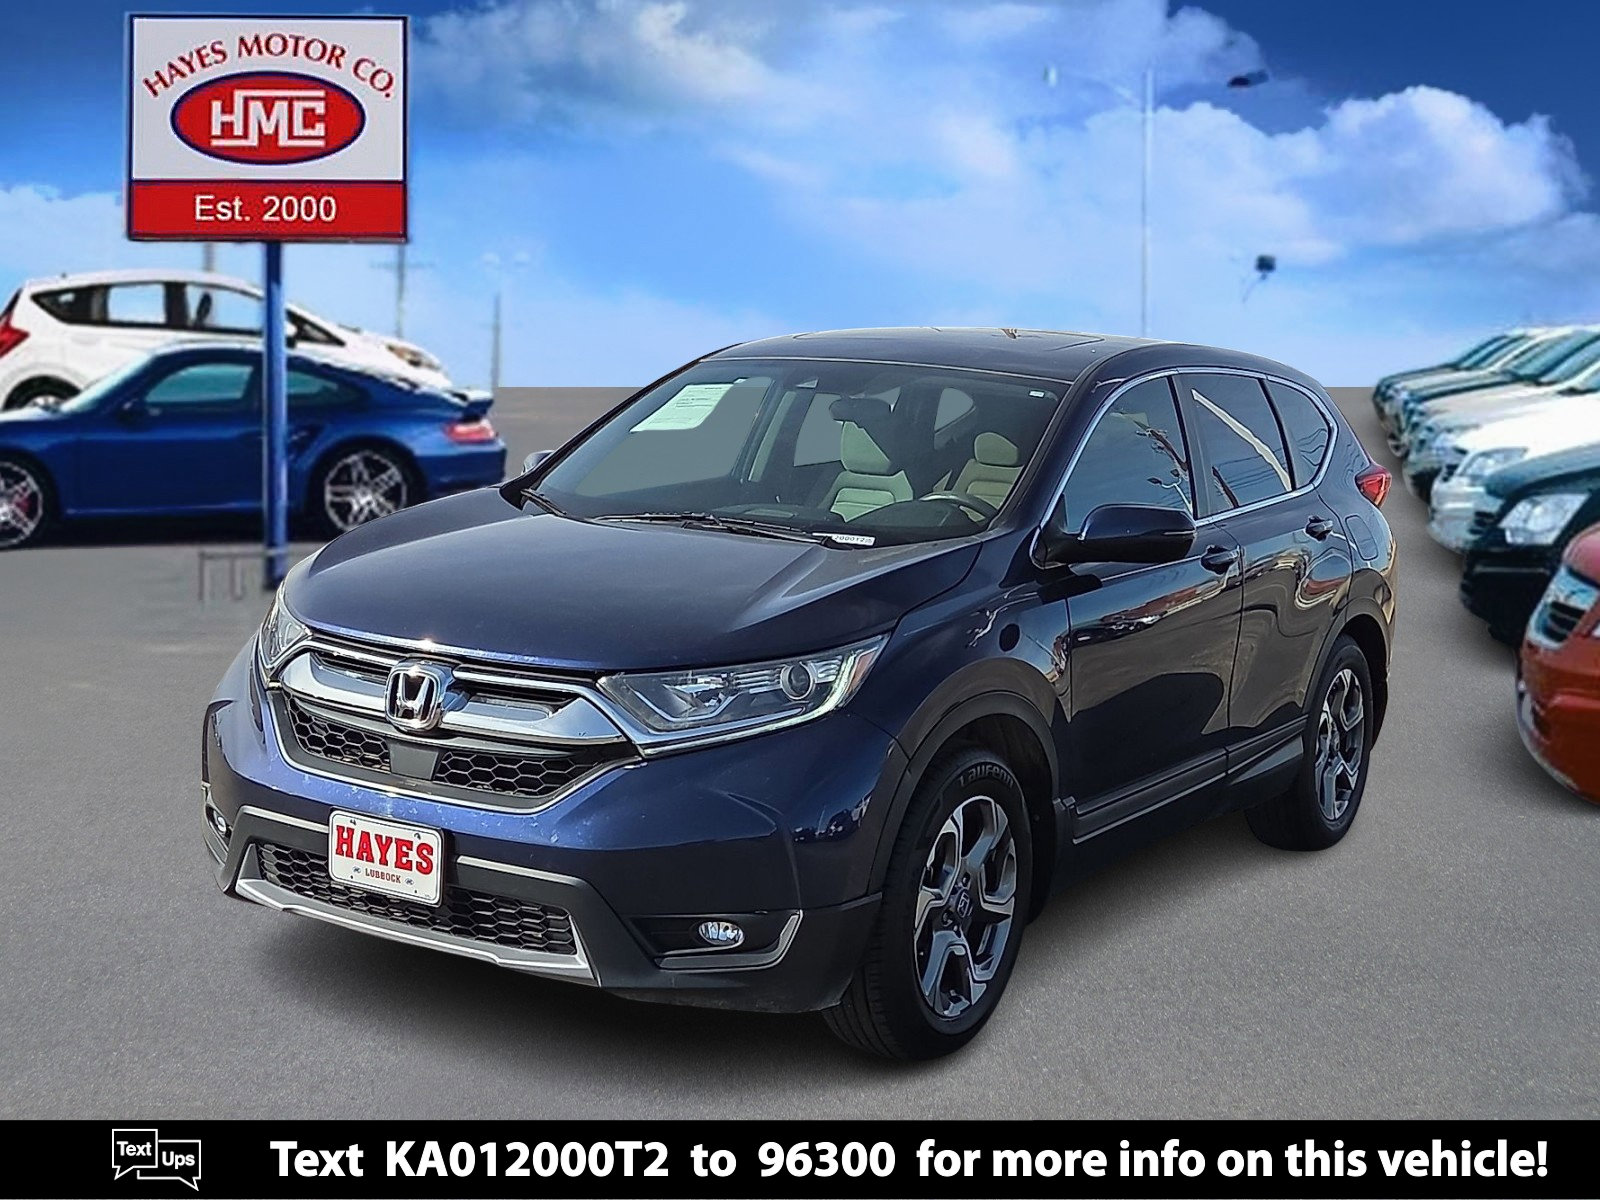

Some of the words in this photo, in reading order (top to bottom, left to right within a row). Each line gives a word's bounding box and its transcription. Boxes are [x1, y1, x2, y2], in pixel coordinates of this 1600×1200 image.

[143, 40, 228, 97] HAYES
[237, 32, 347, 69] MOTOR
[352, 57, 394, 98] CO.
[210, 89, 326, 147] HMC
[194, 194, 251, 222] Est.
[262, 195, 337, 222] 2000
[335, 825, 434, 875] HAYES
[365, 867, 402, 884] LUBBOCK
